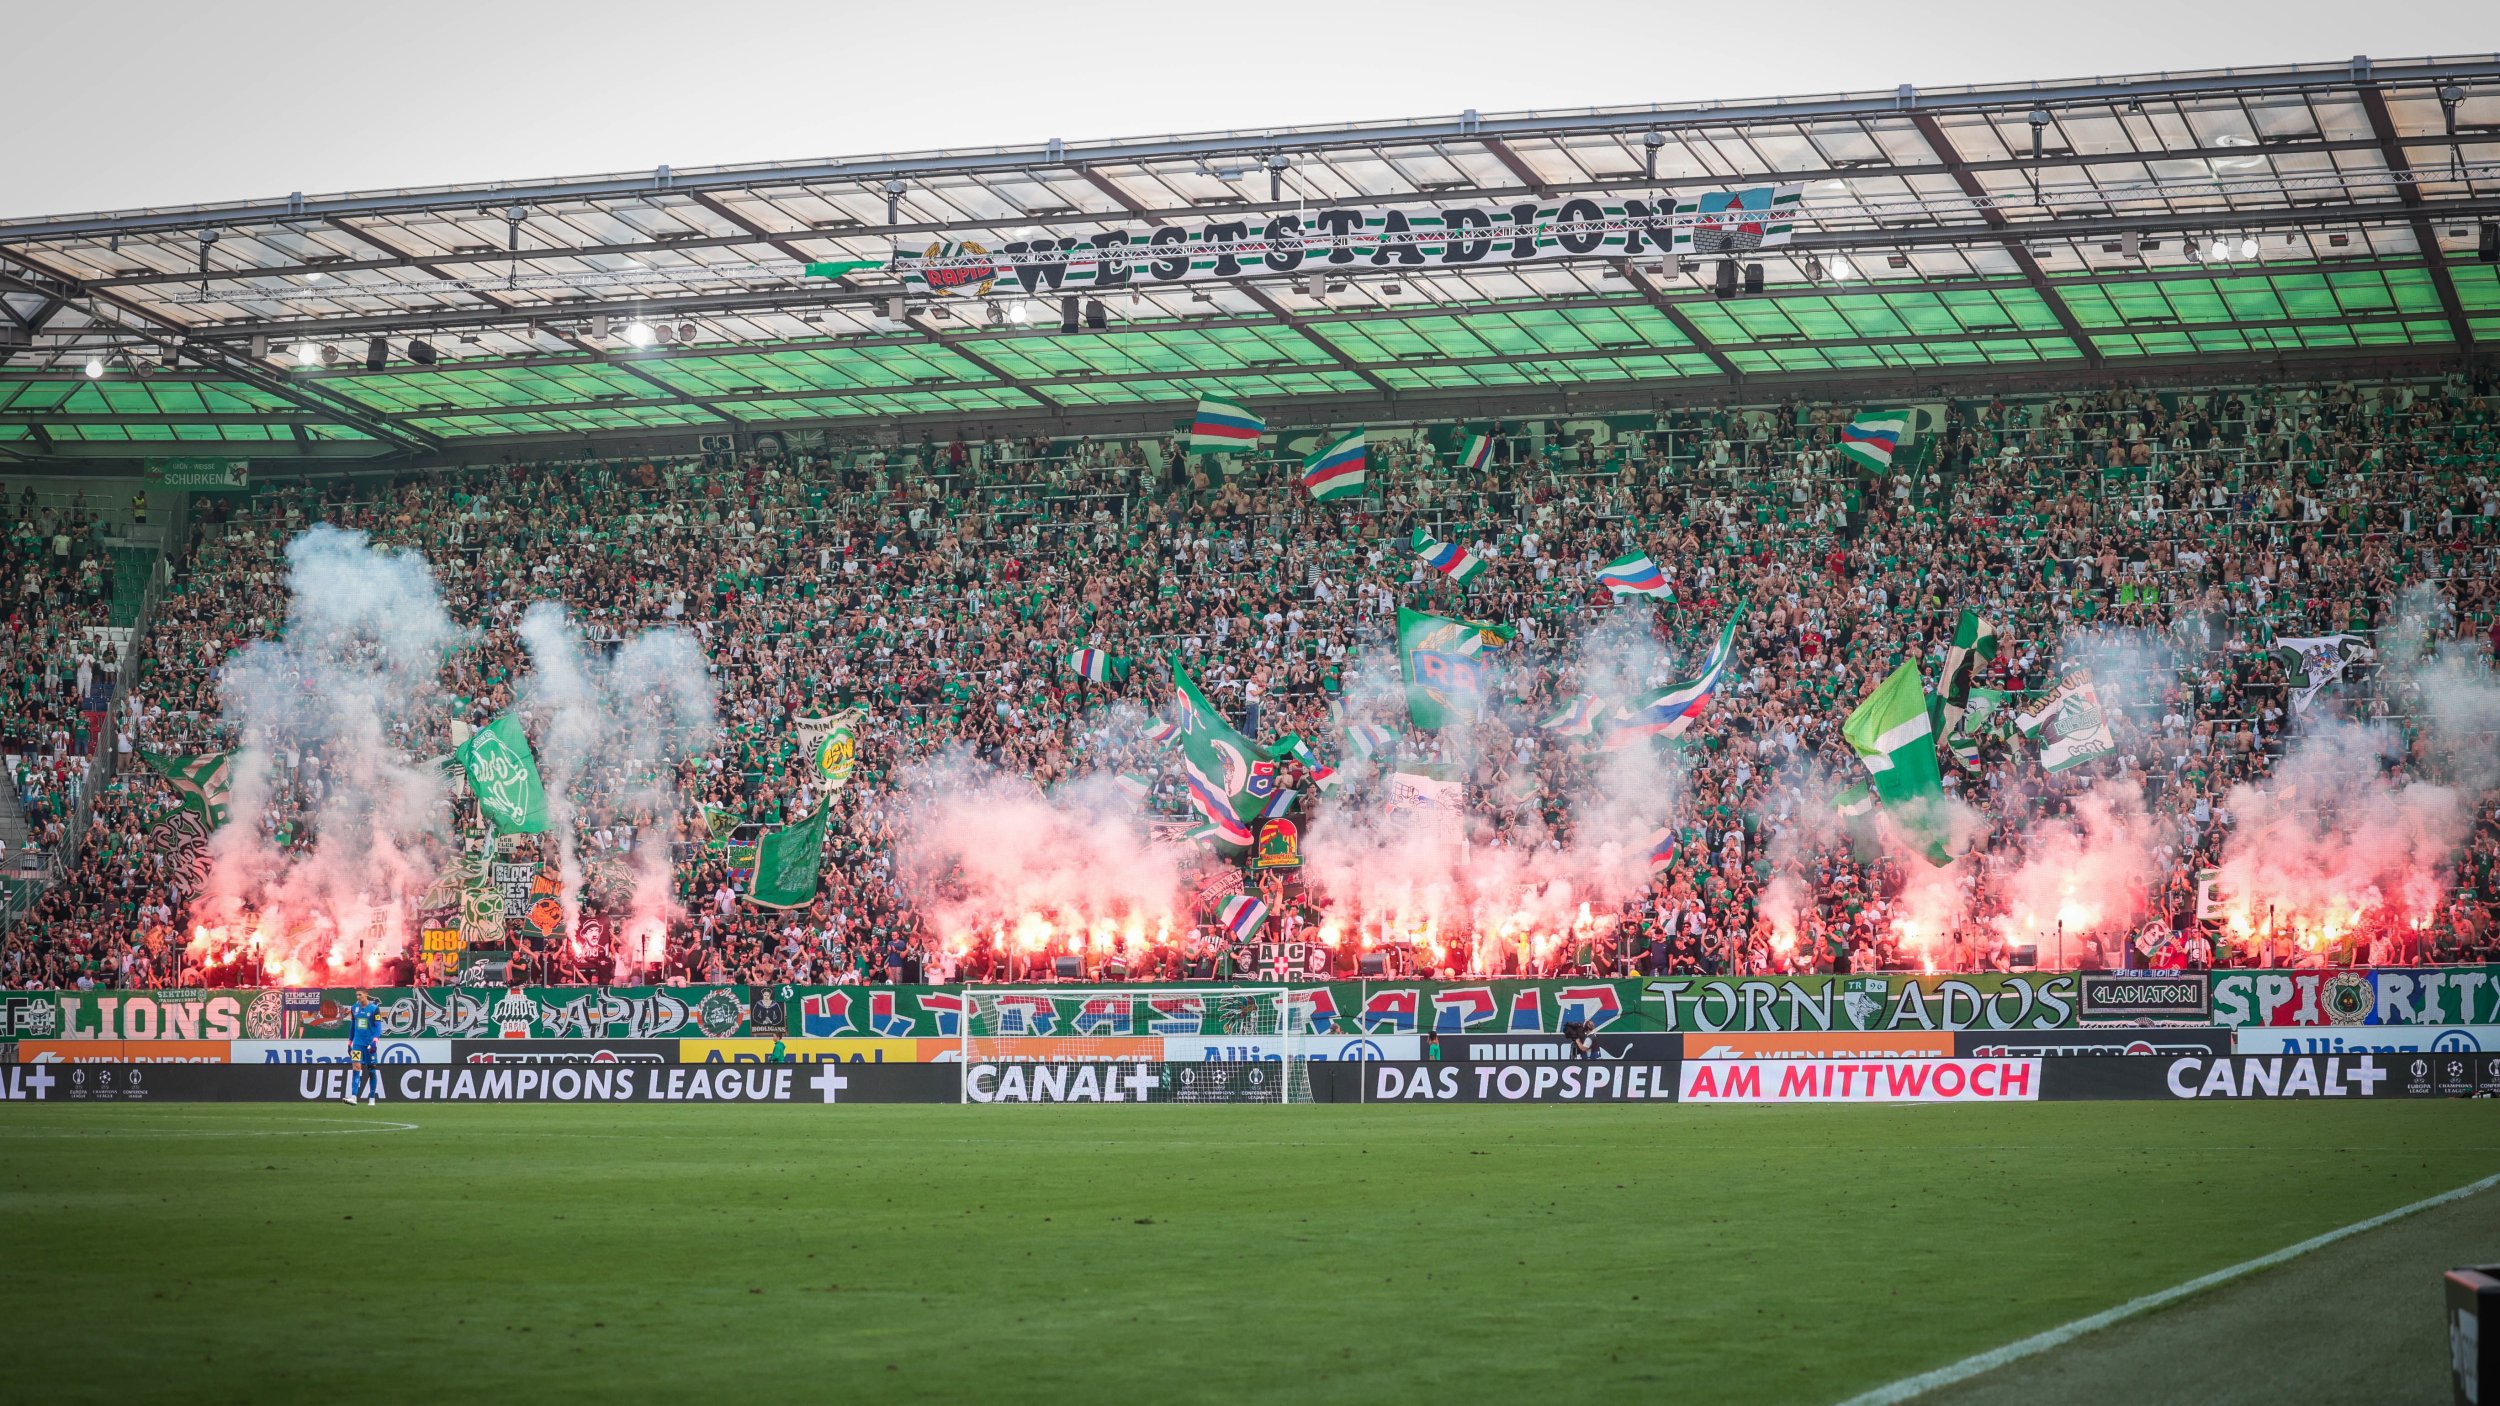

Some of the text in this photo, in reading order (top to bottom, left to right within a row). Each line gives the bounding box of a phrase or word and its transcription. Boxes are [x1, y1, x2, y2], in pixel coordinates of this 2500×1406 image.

[1003, 198, 1679, 293] WESTSTADION
[928, 264, 991, 289] RAPID
[164, 473, 224, 485] SCHURKEN
[495, 865, 535, 883] BLOCK
[157, 989, 197, 998] SEKTION
[801, 983, 1623, 1038] ULTRAS RAPID
[2092, 984, 2198, 1004] GLADIATORI
[60, 996, 241, 1040] LIONS
[382, 986, 489, 1038] ORDS
[400, 1068, 634, 1100] CHAMPIONS
[648, 1068, 793, 1100] LEAGUE
[967, 1063, 1160, 1103] CANAL+
[1376, 1065, 1670, 1100] DAS TOPSPIEL
[1687, 1062, 2032, 1098] AM MITTWOCH
[2167, 1054, 2387, 1099] CANAL+
